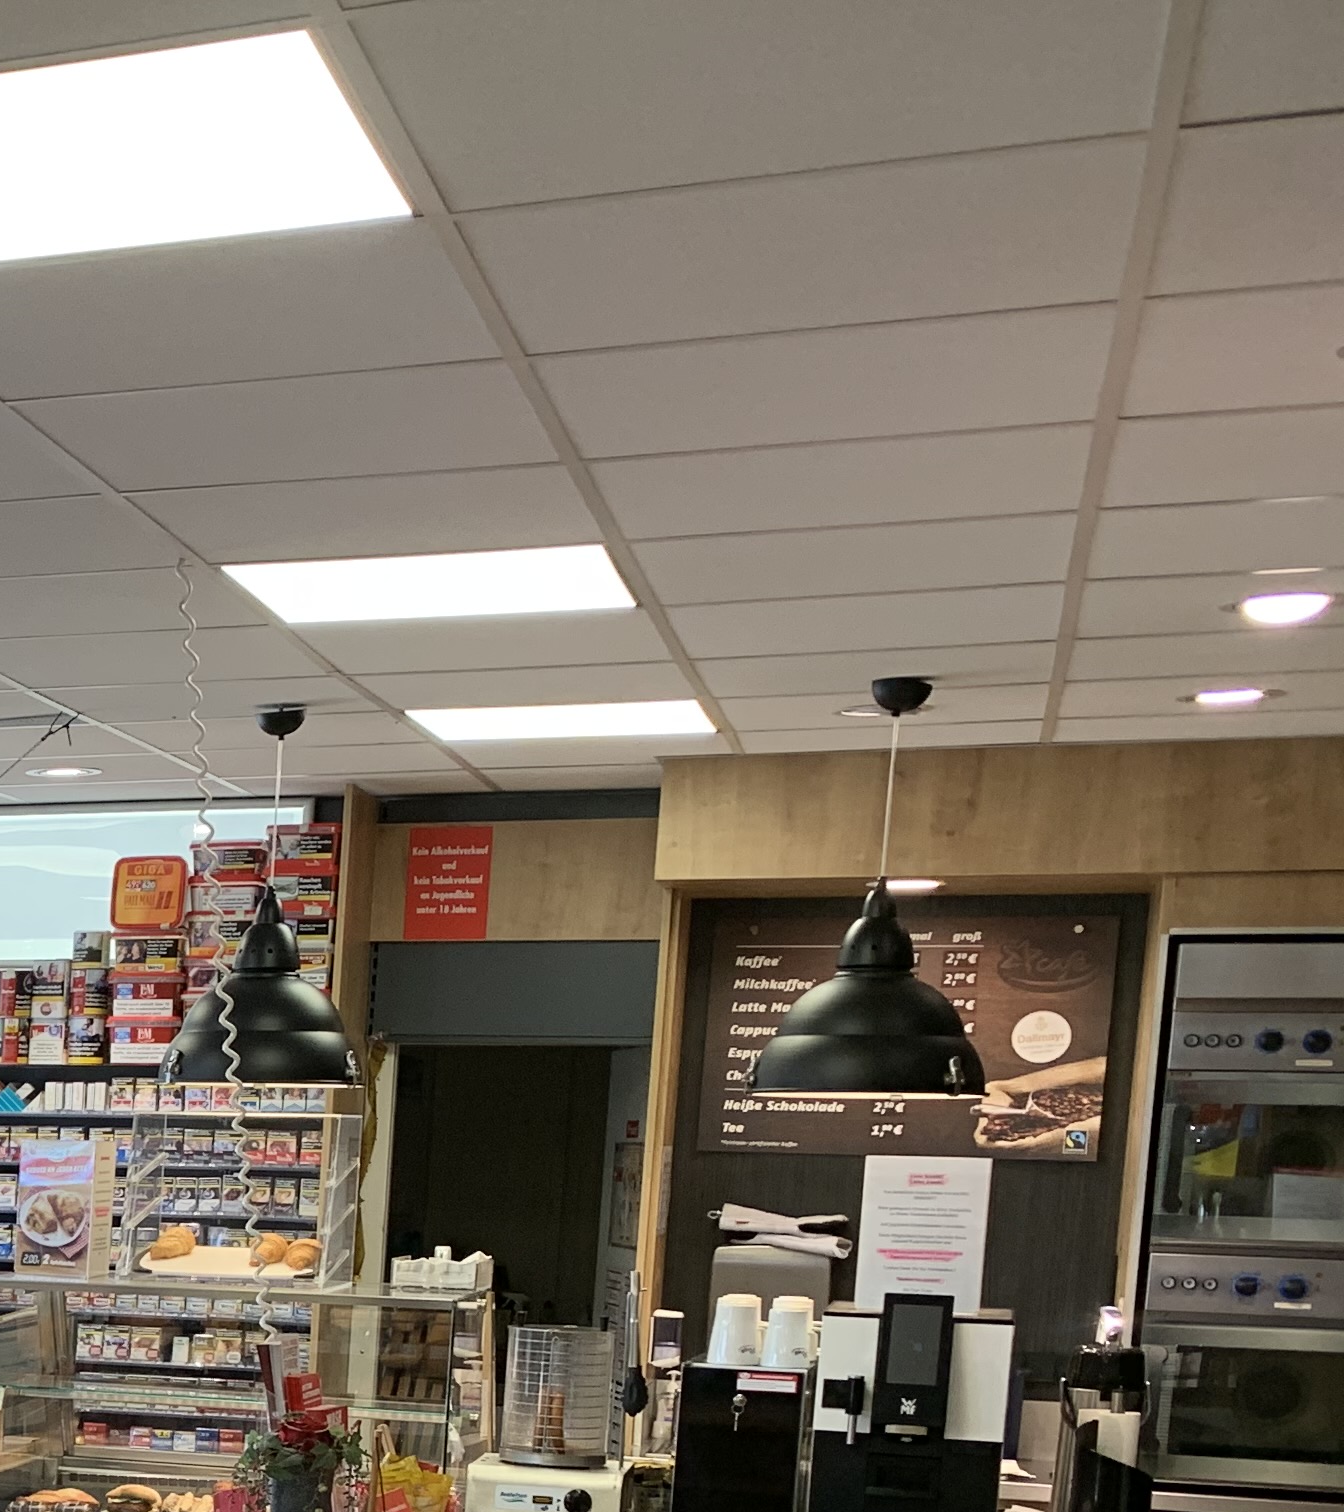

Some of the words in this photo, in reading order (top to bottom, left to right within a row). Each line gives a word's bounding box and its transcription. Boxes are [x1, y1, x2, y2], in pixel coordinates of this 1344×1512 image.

[413, 846, 430, 857] Kein
[431, 845, 489, 857] Alkoholverkauf
[134, 865, 166, 876] GIGA
[442, 861, 456, 871] und
[414, 875, 430, 886] kein
[432, 874, 483, 885] Tabakverkauf
[420, 891, 430, 899] an
[431, 890, 474, 901] Jugendliche
[416, 905, 437, 914] unter
[440, 905, 449, 914] 18
[451, 905, 477, 914] Jahren
[953, 931, 982, 943] groß
[732, 1002, 767, 1013] Latte
[1017, 1031, 1065, 1045] Dallmayr
[723, 1100, 763, 1113] Heiße
[766, 1100, 846, 1113] Schokolade
[722, 1122, 744, 1133] Tee
